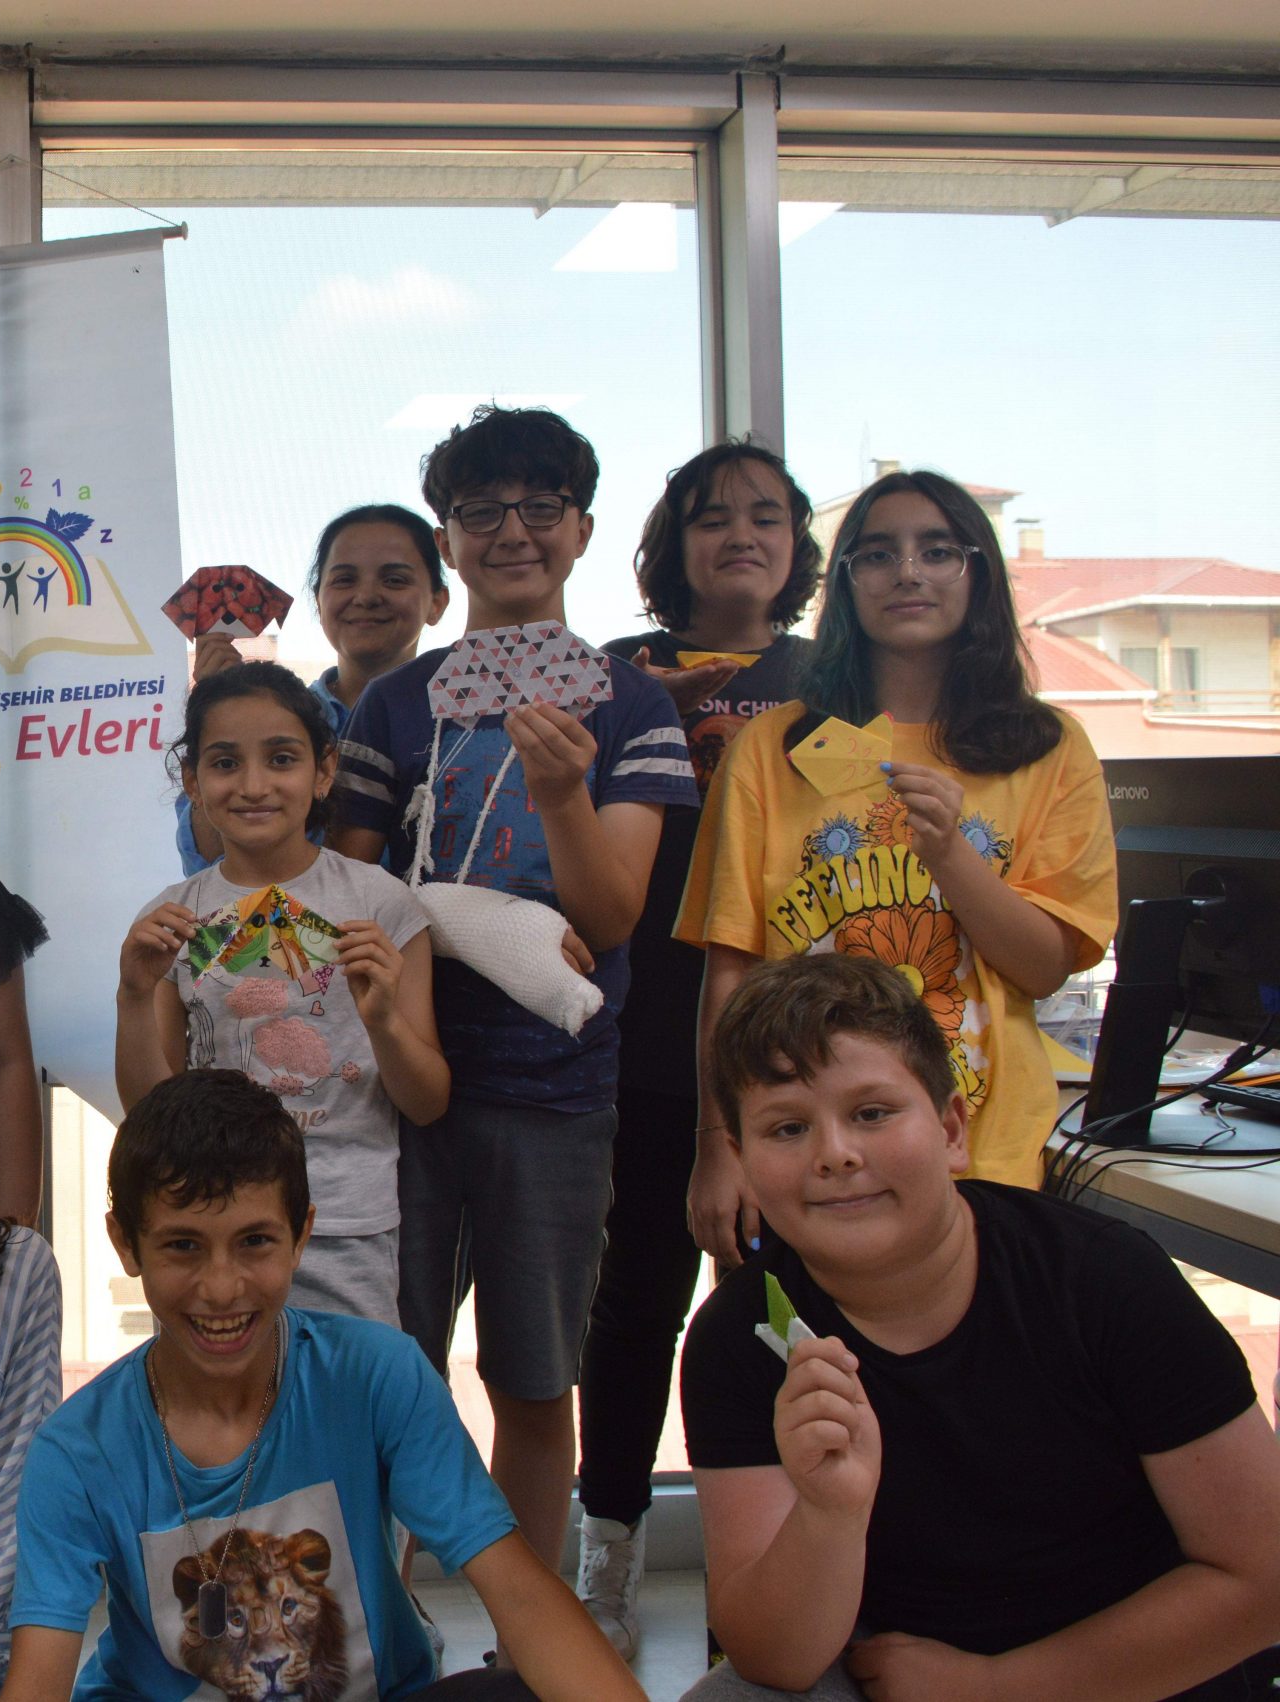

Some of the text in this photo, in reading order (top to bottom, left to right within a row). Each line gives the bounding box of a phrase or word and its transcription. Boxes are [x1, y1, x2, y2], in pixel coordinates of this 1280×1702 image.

[19, 467, 33, 488] 2
[51, 478, 62, 497] 1
[78, 485, 91, 500] a
[60, 675, 165, 703] BELEDİYESİ
[699, 699, 730, 714] ON
[16, 703, 163, 761] Evleri
[1107, 783, 1150, 800] Lenovo
[769, 843, 934, 953] FEELING
